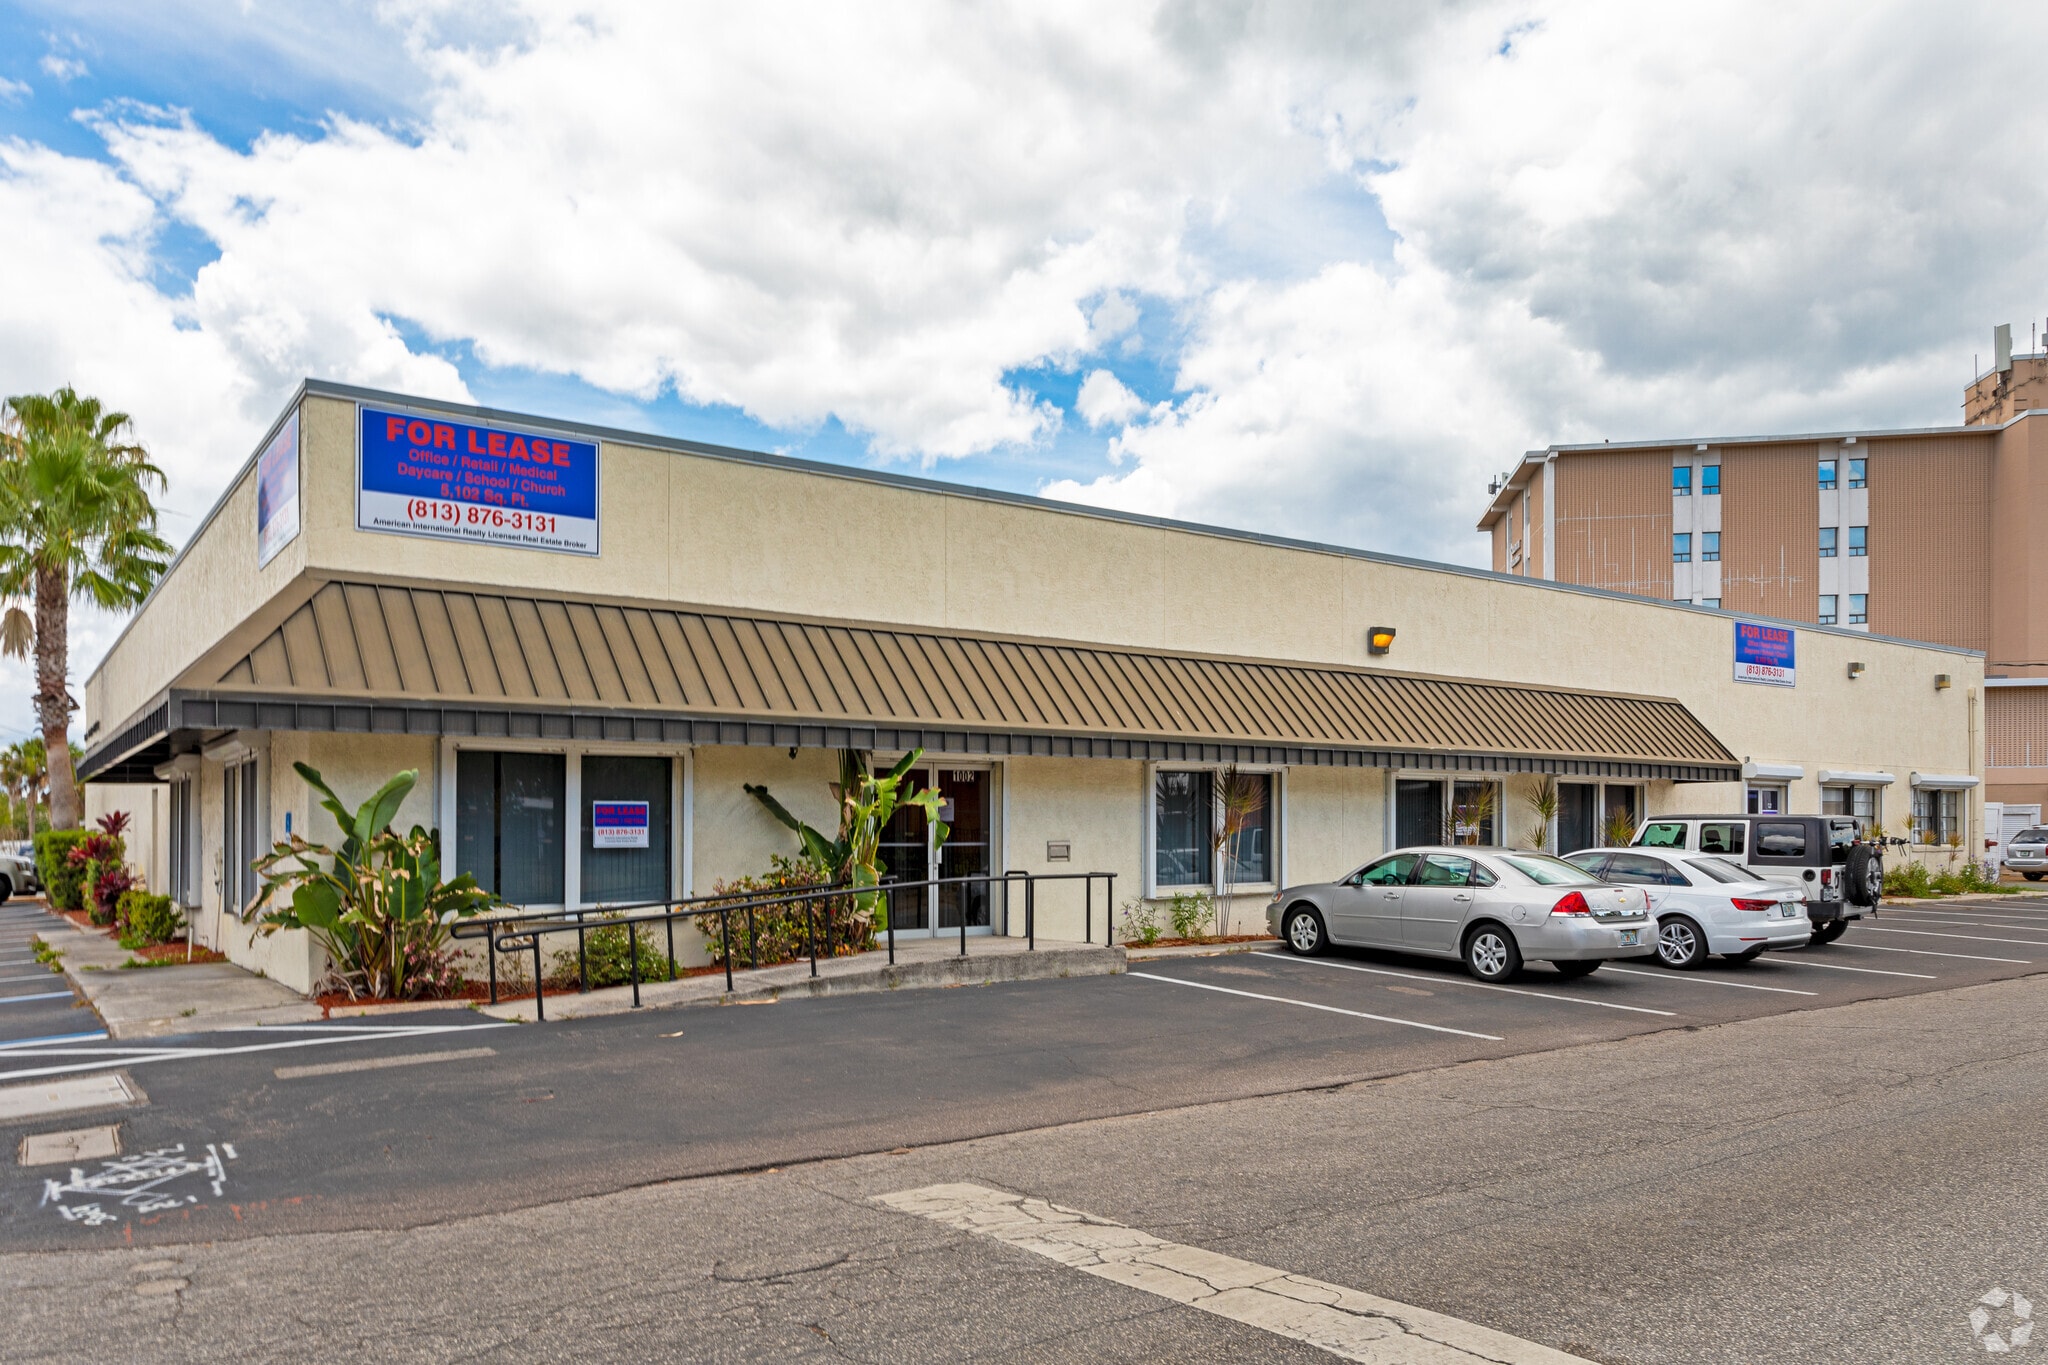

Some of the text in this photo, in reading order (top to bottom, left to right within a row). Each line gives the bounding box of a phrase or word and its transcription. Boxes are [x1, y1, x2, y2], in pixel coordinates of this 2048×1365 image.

[386, 416, 571, 468] FOR LEASE
[408, 448, 449, 465] Office
[461, 455, 499, 473] Retail
[509, 462, 557, 481] Medical
[397, 461, 453, 480] Daycare
[464, 471, 510, 489] School
[521, 479, 566, 497] Church
[440, 483, 530, 508] 5,102 Sq. Ft.
[407, 498, 556, 534] (813) 876-3131
[373, 517, 587, 550] American International Realty Licensed Real Estate Broker
[1741, 625, 1788, 643] FOR LEASE
[1746, 664, 1785, 678] (813) 876-3131
[953, 770, 975, 782] 1002
[596, 806, 647, 815] FOR LEASE
[598, 828, 615, 836] (813)
